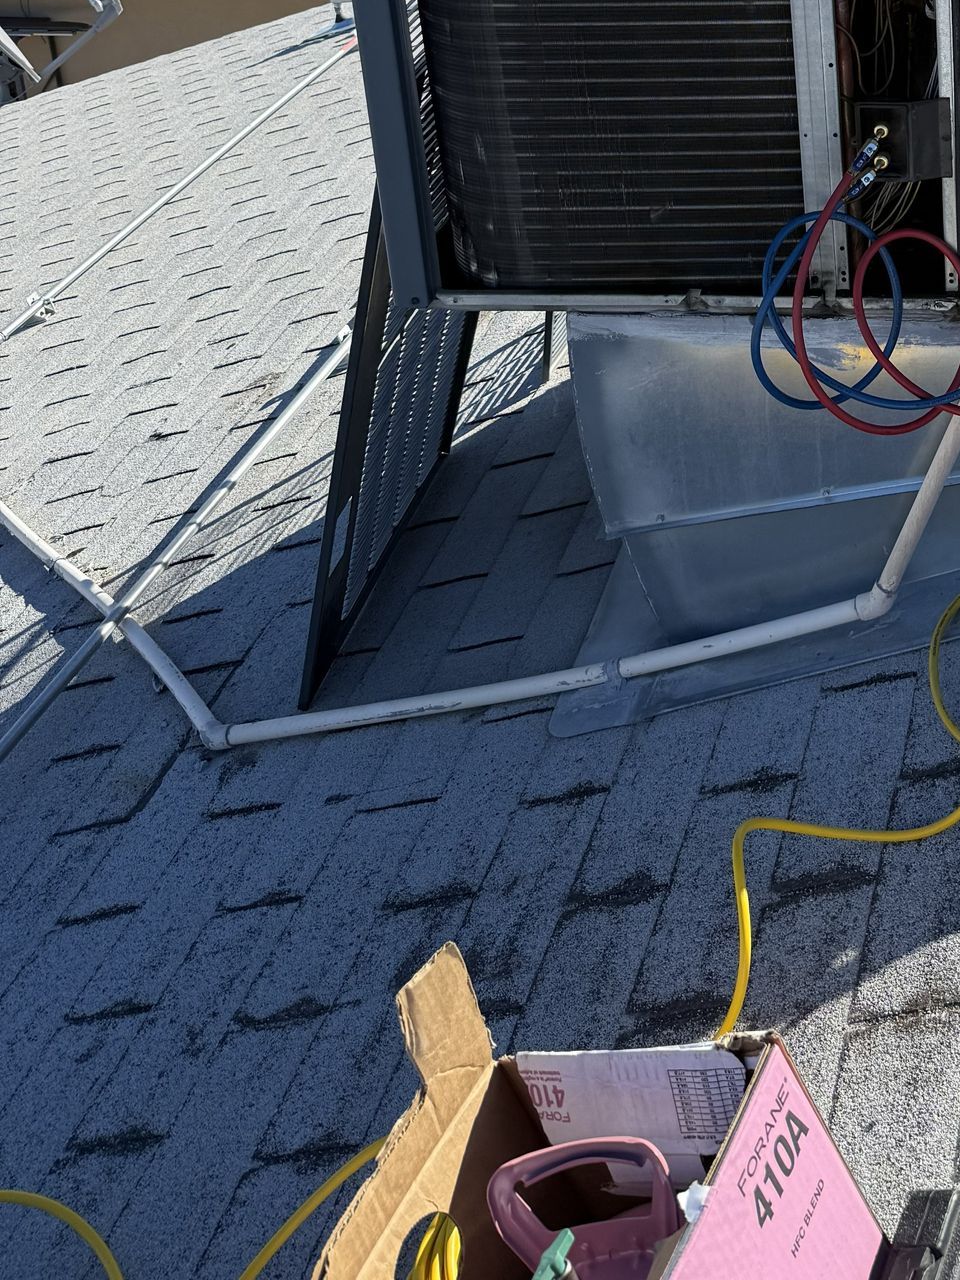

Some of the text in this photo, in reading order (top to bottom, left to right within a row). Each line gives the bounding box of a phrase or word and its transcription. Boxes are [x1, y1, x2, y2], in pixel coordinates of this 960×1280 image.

[530, 1084, 565, 1108] 410
[538, 1111, 571, 1123] FORA
[736, 1084, 790, 1197] FORANE
[753, 1109, 810, 1229] 410A
[790, 1178, 825, 1259] HFC BLEND
